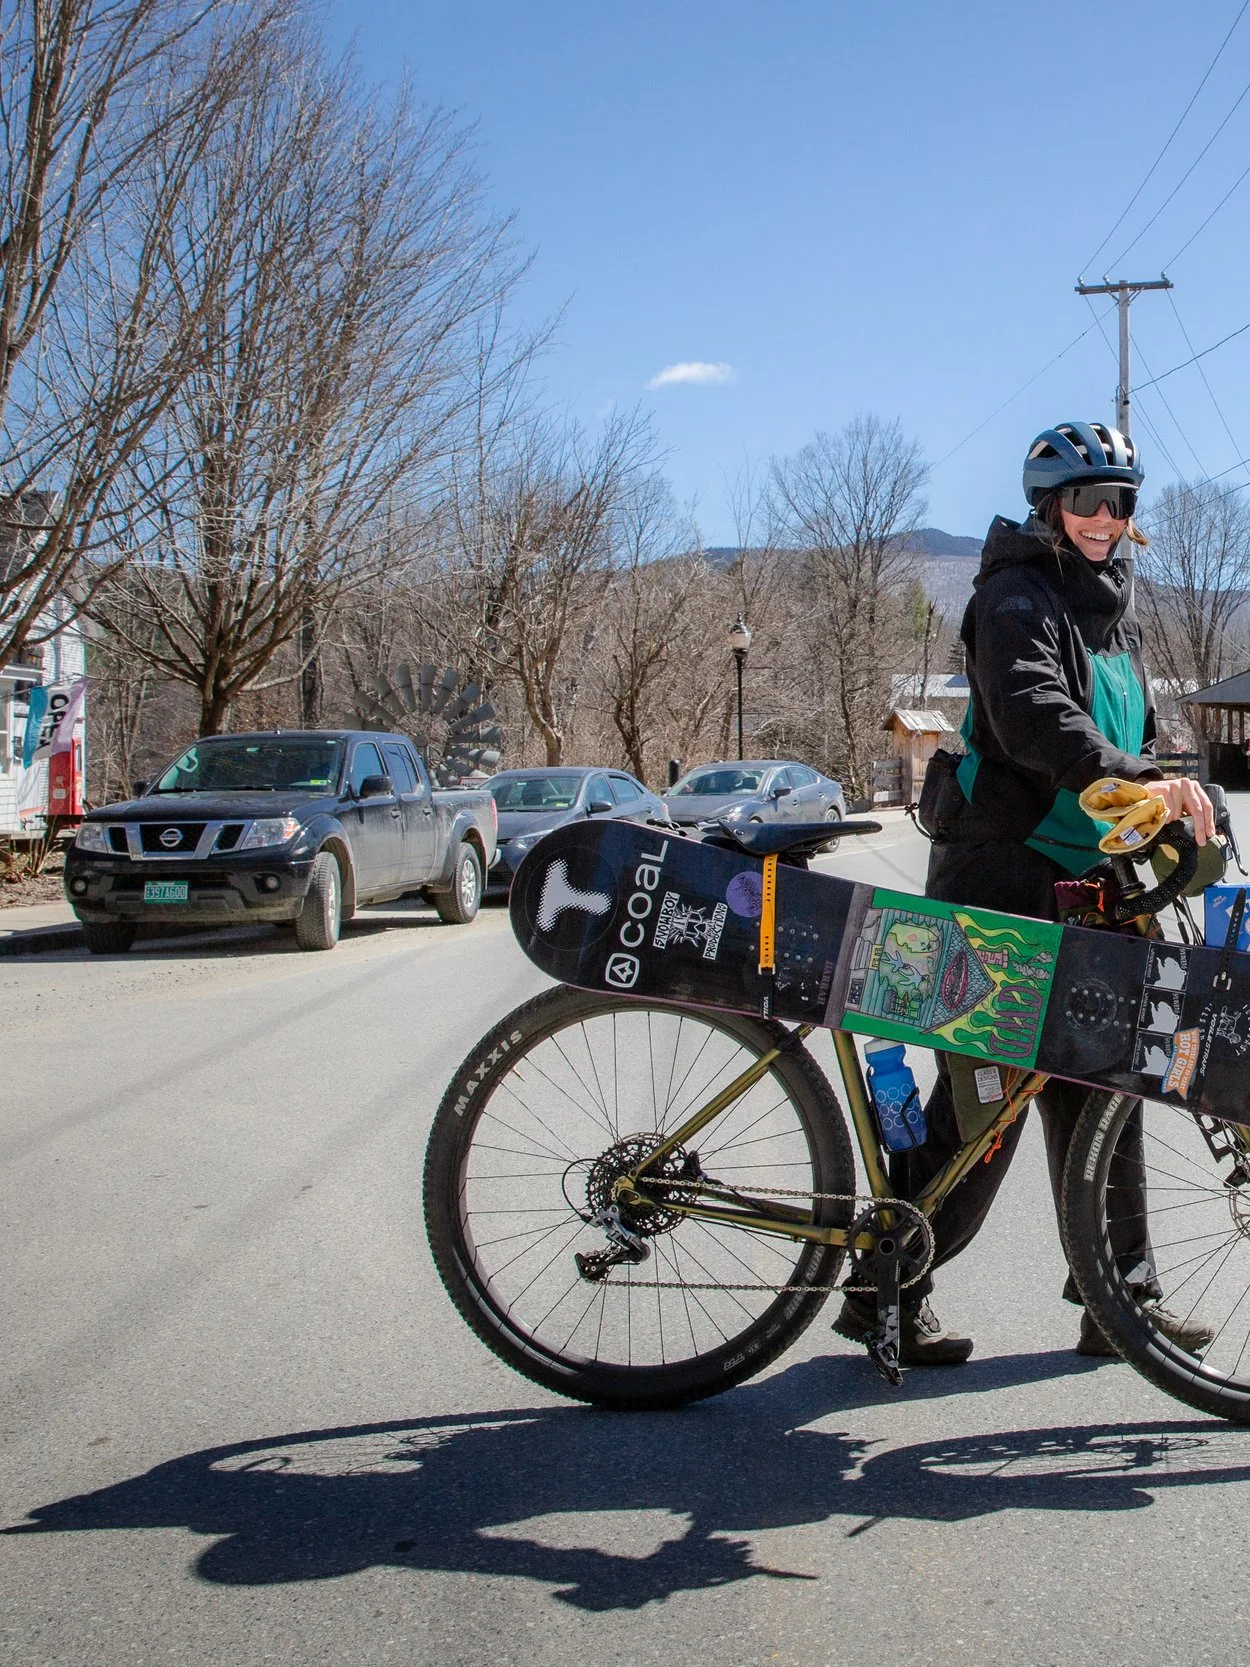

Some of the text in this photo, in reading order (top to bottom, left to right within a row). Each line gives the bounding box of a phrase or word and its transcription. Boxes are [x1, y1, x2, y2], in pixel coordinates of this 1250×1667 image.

[654, 892, 680, 948] SNOWBOY
[705, 903, 728, 959] PRODUCTIONS
[1179, 1033, 1191, 1056] HOT
[1207, 1013, 1218, 1043] VOILE
[453, 1030, 522, 1117] MAXXIS
[1168, 1057, 1187, 1088] GIRLS
[1200, 1042, 1211, 1077] STRAPS
[1084, 1129, 1106, 1182] REKON
